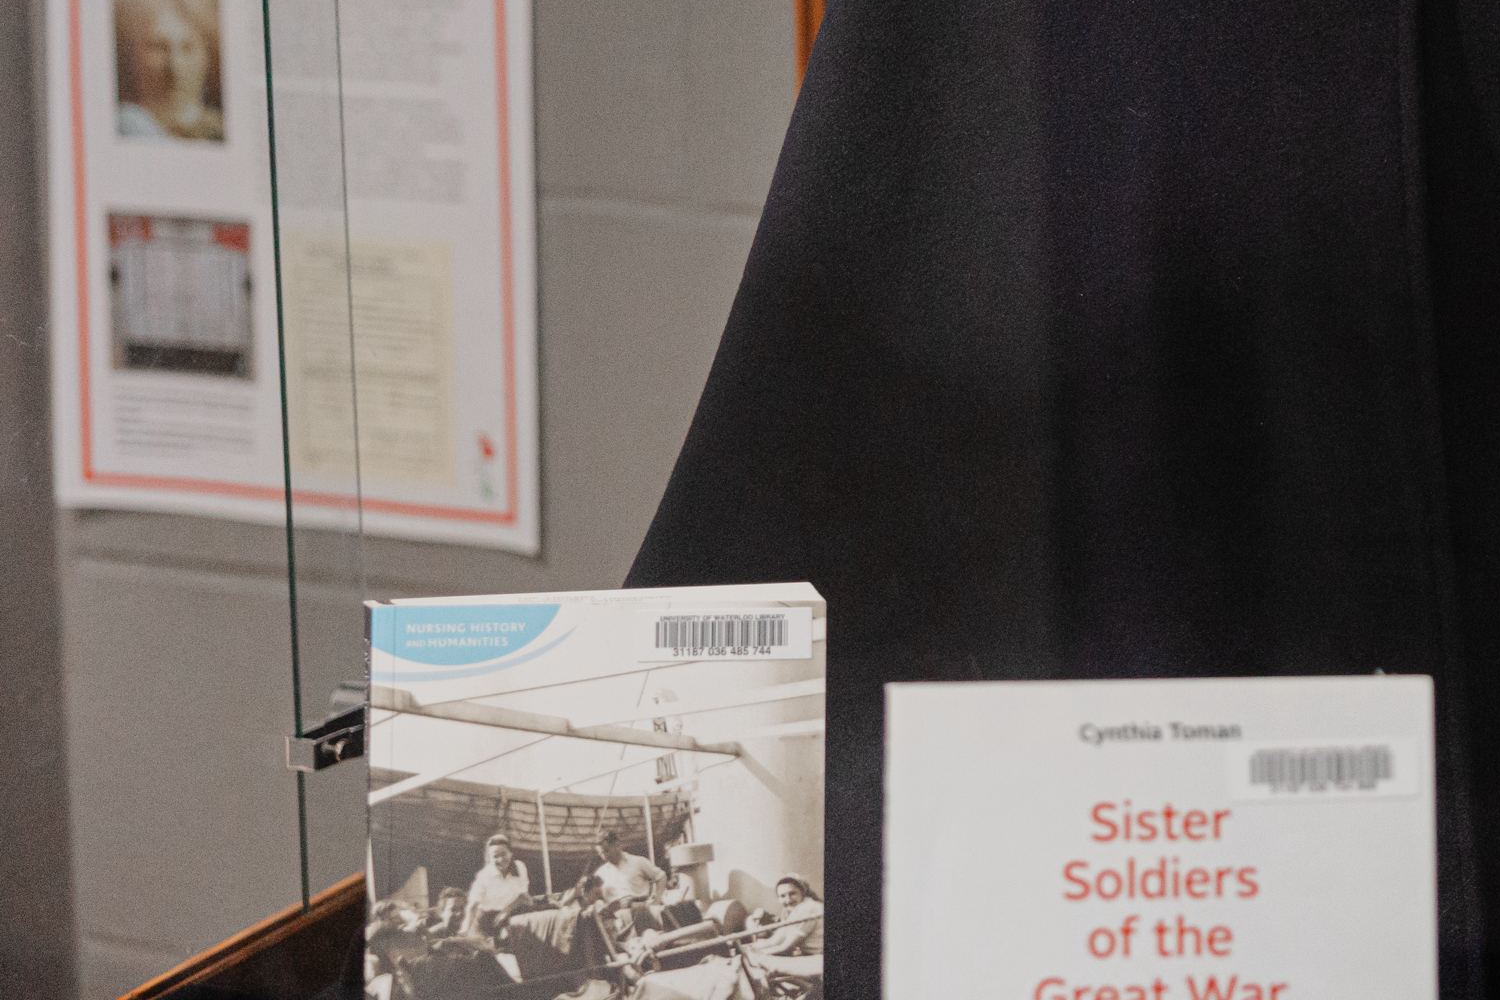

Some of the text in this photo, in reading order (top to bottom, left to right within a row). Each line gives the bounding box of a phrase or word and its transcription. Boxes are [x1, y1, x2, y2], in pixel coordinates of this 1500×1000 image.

[406, 622, 526, 634] NURSING HISTORY
[406, 637, 509, 648] AND HUMANITIES
[673, 645, 771, 657] 31187 036 485 744
[1078, 721, 1242, 746] Cynthia Toman
[1090, 799, 1232, 842] Sister
[1062, 857, 1260, 901] Soldiers
[1087, 914, 1234, 959] of the
